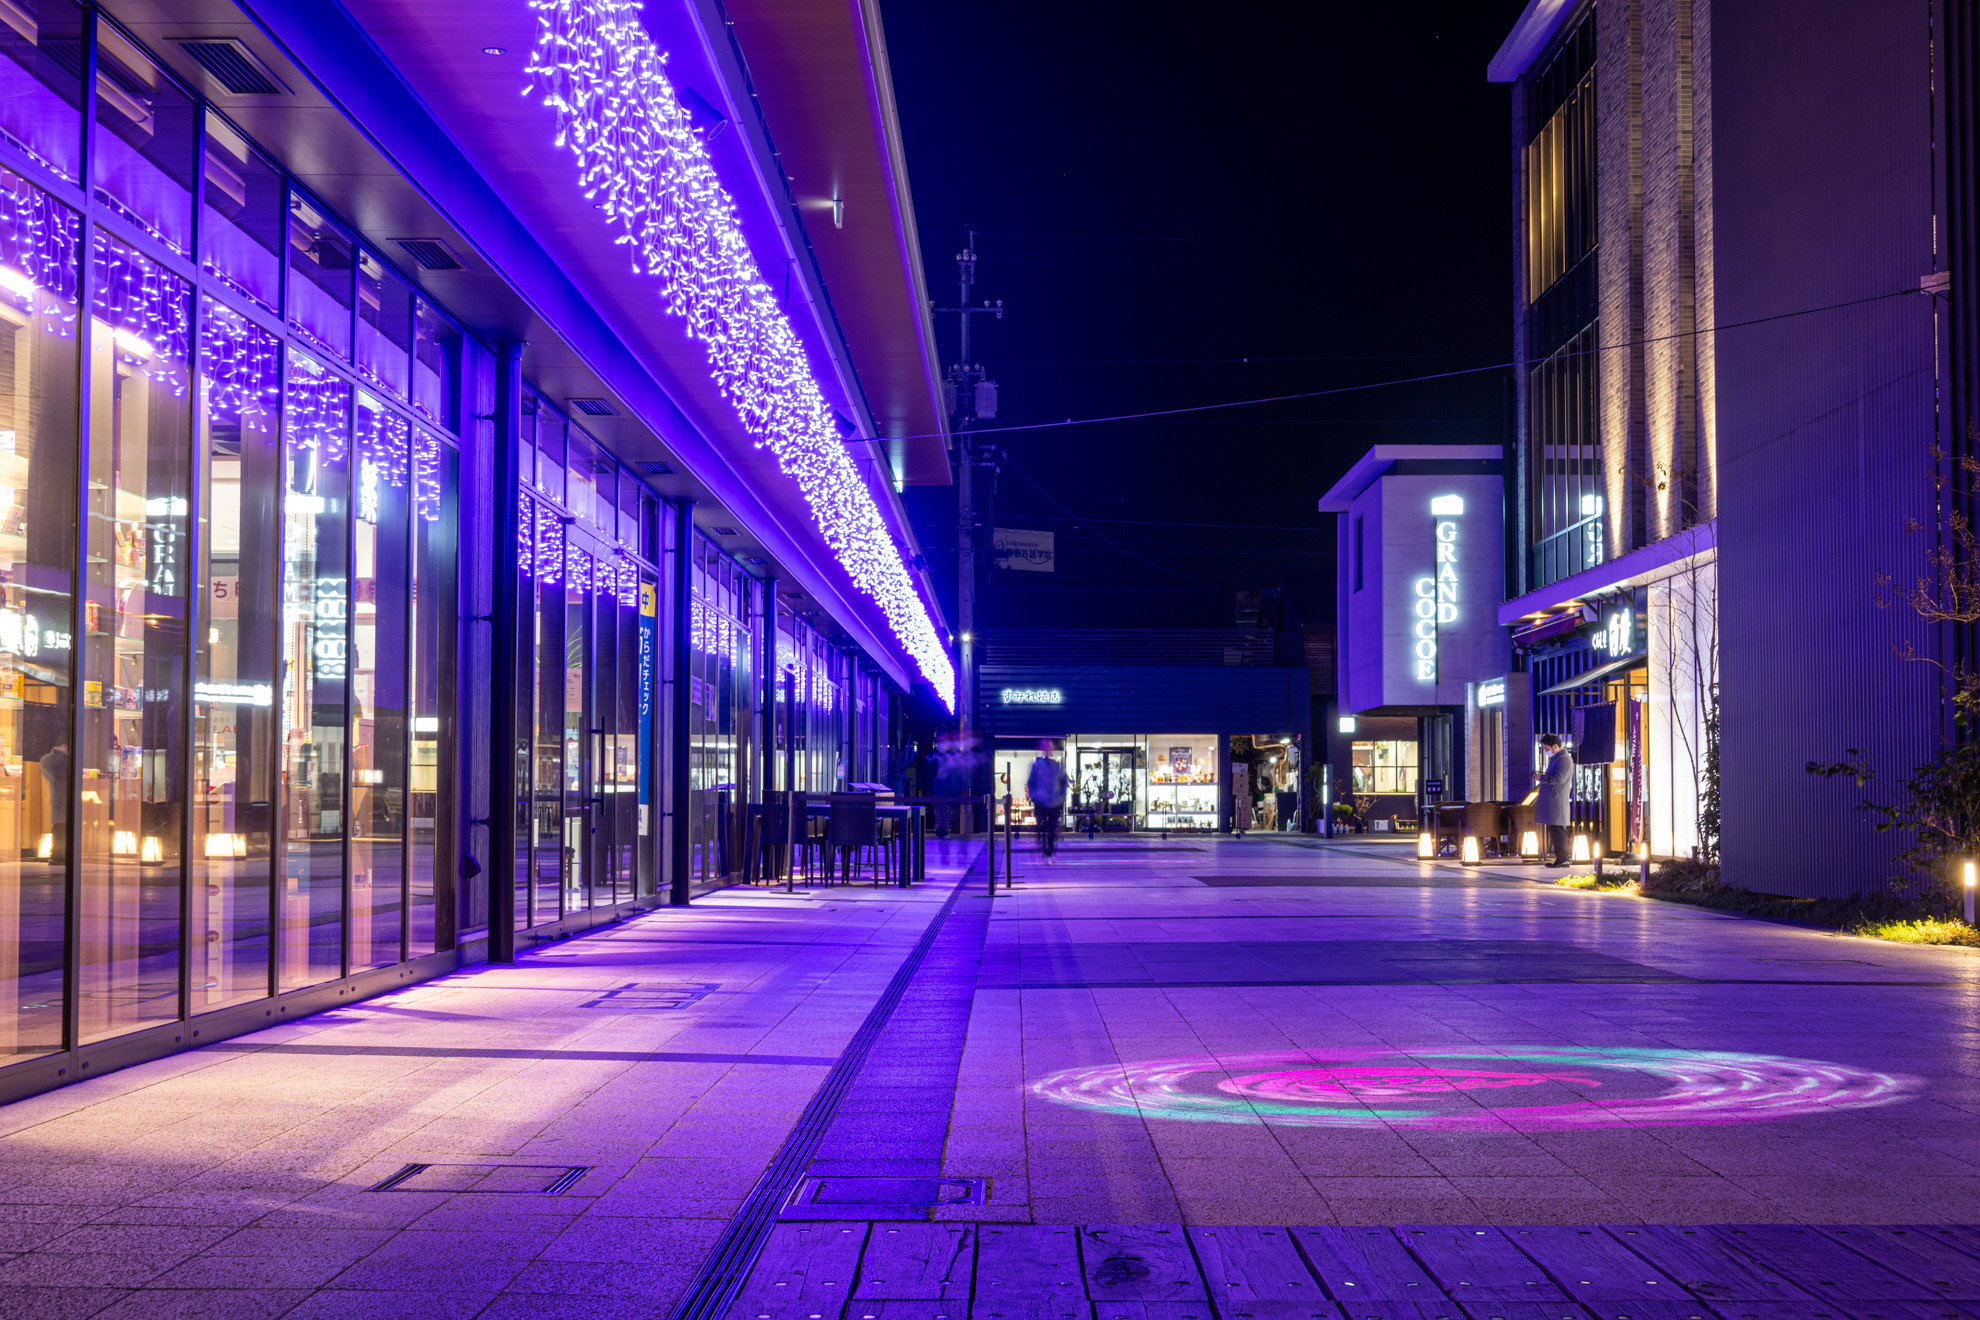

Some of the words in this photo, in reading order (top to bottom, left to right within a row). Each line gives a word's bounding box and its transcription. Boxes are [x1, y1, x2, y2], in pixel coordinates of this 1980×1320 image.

[1437, 522, 1458, 623] GRAND
[643, 627, 651, 715] からだチェック
[1415, 578, 1437, 679] COCOE
[1001, 688, 1060, 704] すみれ花店
